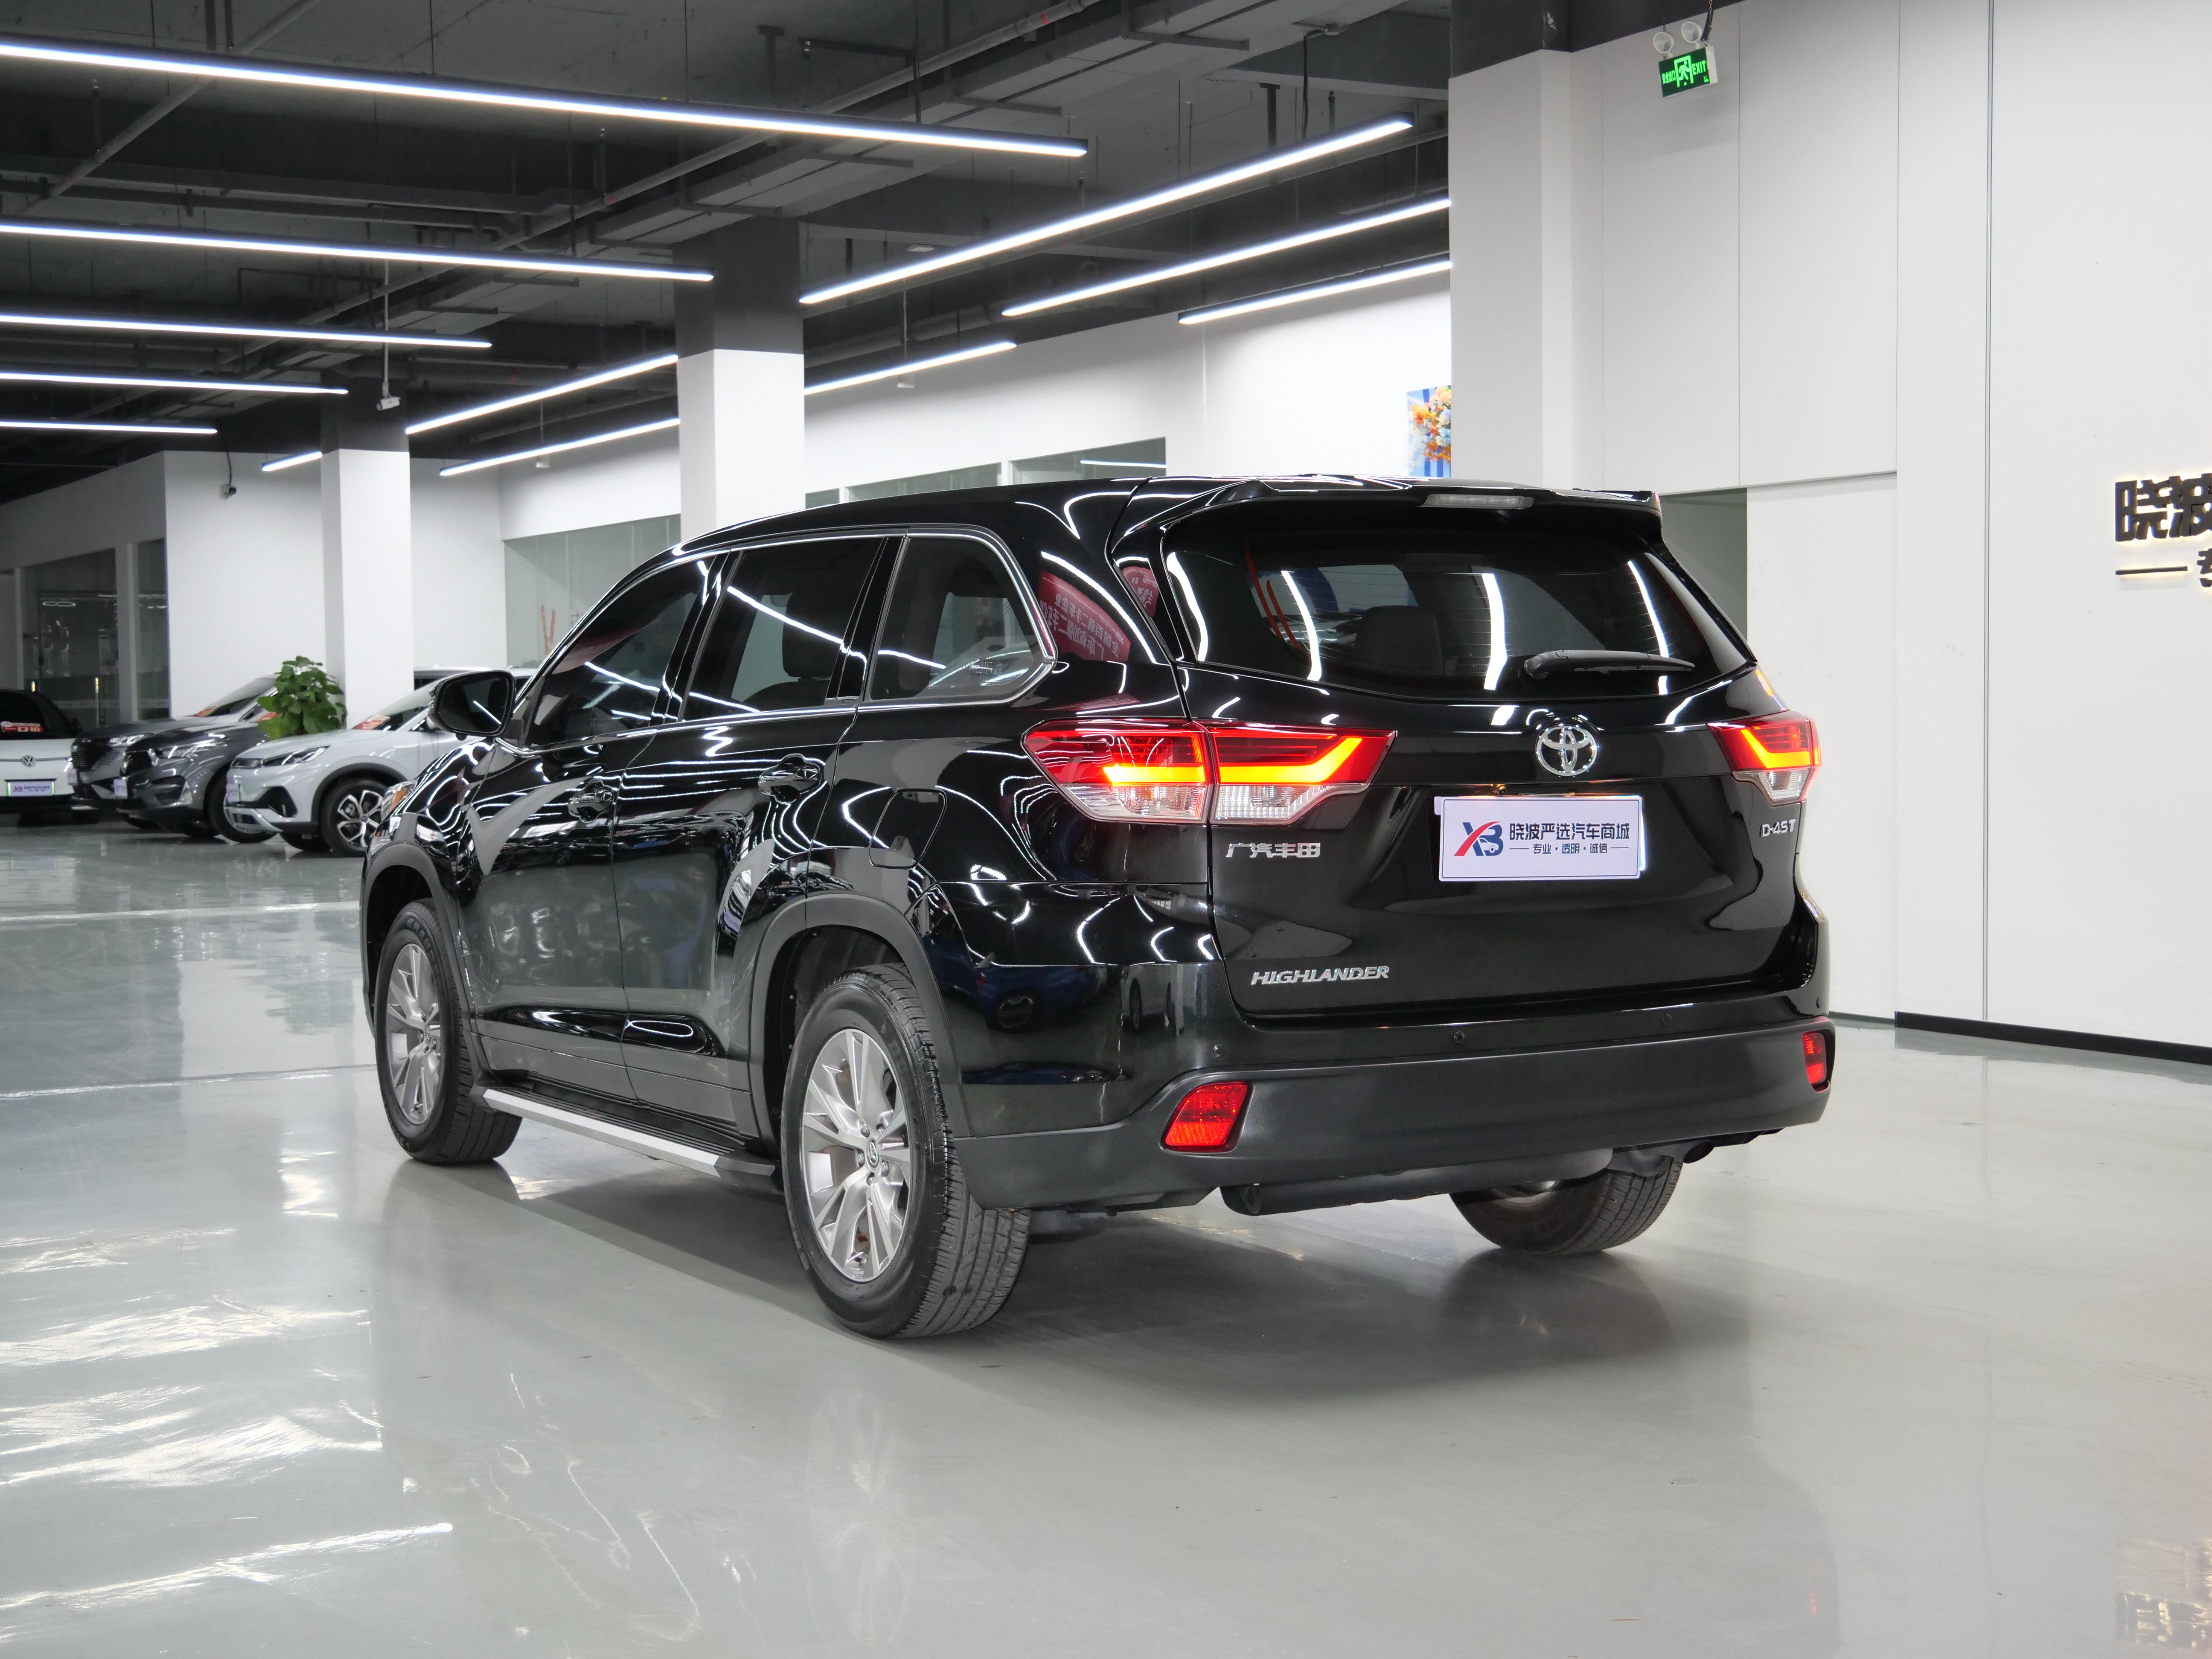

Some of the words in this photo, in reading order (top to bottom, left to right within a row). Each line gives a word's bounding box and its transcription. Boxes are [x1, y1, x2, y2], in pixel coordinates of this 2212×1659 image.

[1692, 60, 1706, 75] EXIT
[1509, 823, 1630, 840] 晓波严选汽车商城
[1226, 842, 1321, 858] 广汽丰田
[1251, 966, 1390, 985] HIGHLANDER
